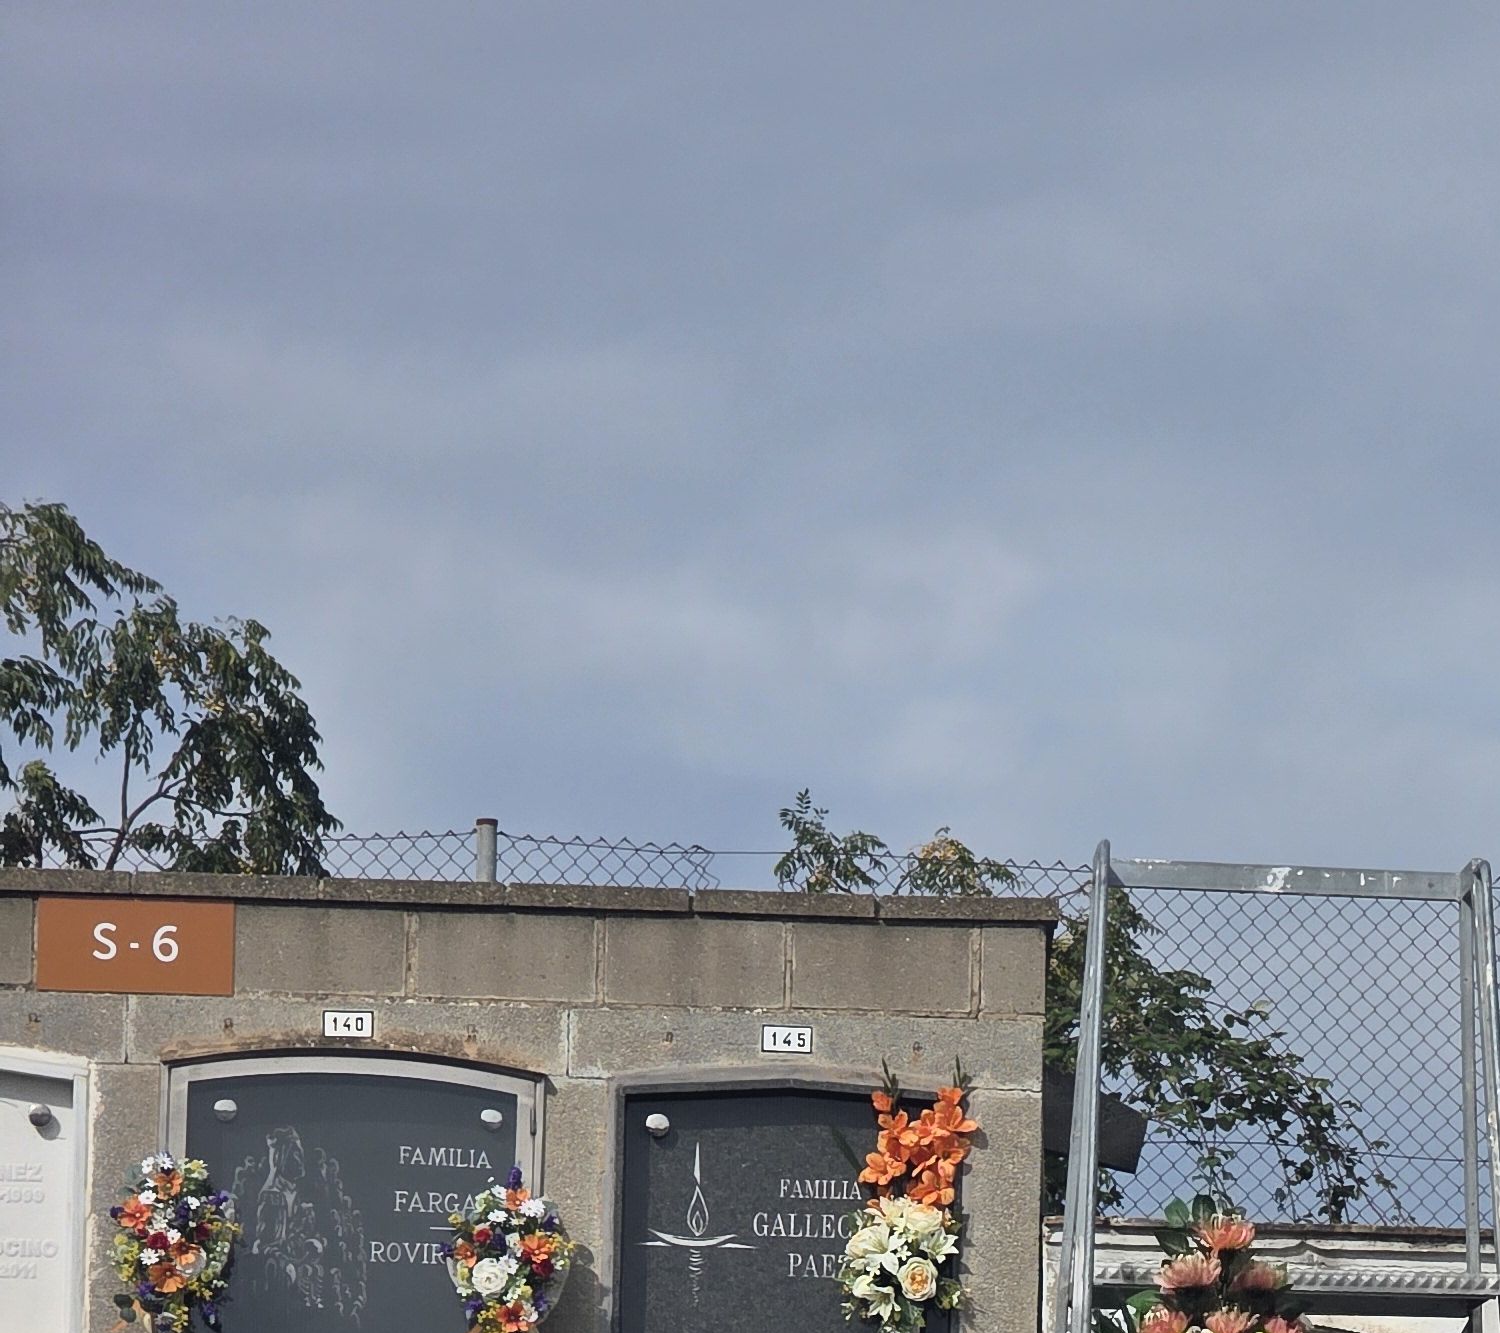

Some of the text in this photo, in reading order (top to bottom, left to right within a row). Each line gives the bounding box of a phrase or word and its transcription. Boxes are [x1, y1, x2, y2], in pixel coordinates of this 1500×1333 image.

[332, 1017, 364, 1033] 140
[771, 1032, 806, 1048] 145
[399, 1145, 493, 1169] FAMILIA
[779, 1179, 862, 1200] FAMILIA
[393, 1190, 476, 1213] FARGA
[369, 1242, 445, 1265] ROVIR
